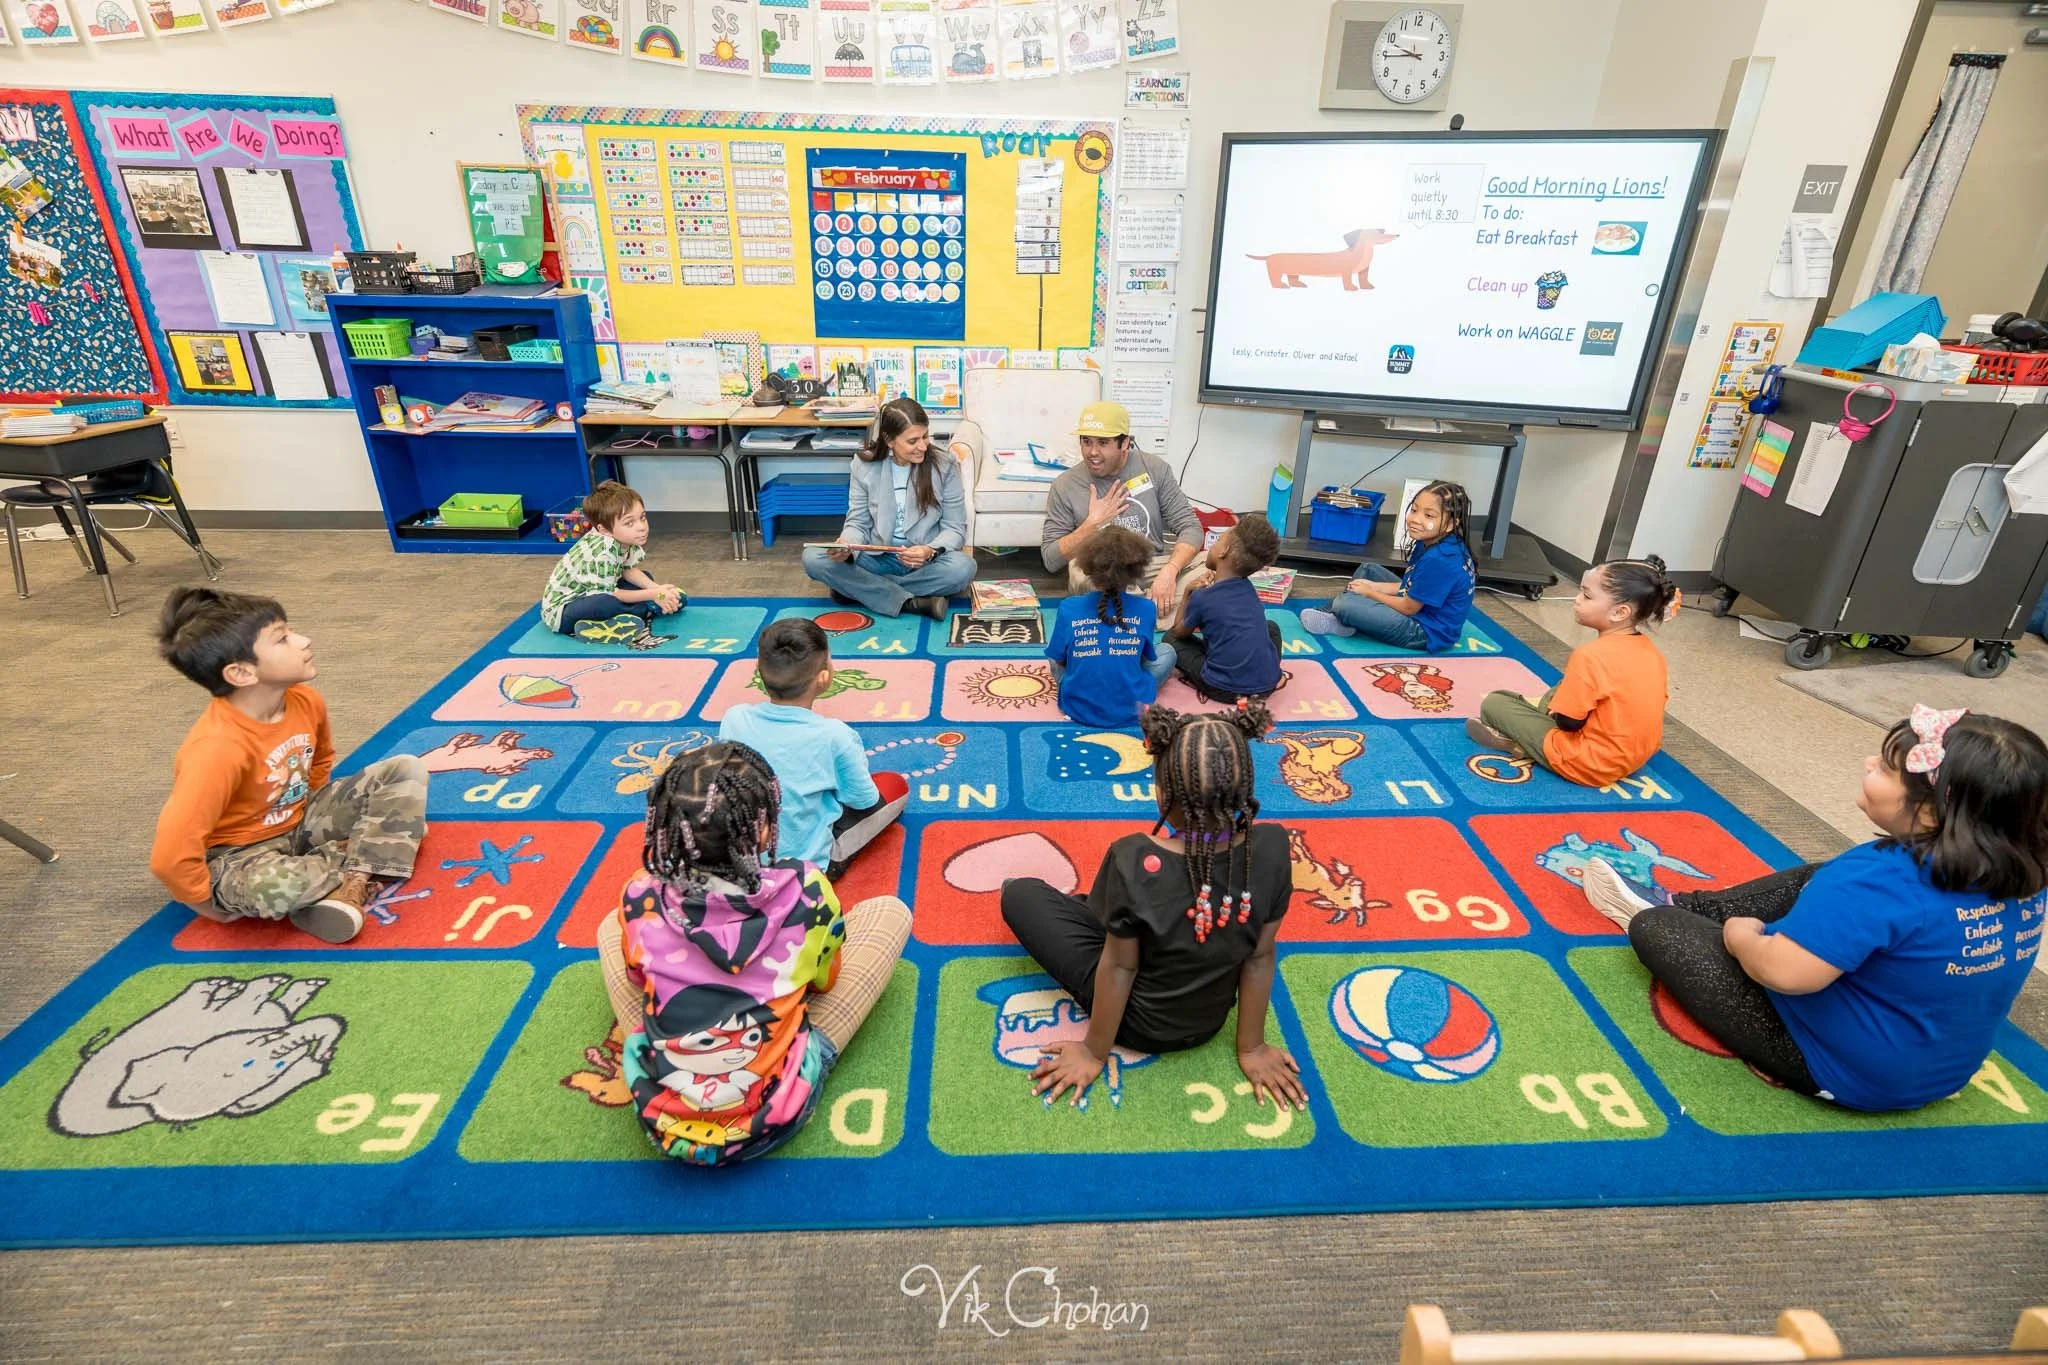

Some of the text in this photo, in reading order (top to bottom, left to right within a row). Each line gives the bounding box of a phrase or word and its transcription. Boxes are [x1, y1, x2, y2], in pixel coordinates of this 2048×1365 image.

[711, 5, 740, 35] Ss
[1013, 11, 1048, 38] Xx
[1400, 19, 1408, 31] 11
[1414, 15, 1424, 27] 12
[775, 14, 800, 41] Tt
[832, 17, 865, 43] Uu
[944, 16, 990, 43] Ww
[1387, 32, 1396, 44] 10
[1437, 33, 1443, 45] 2
[1382, 50, 1388, 61] 9
[1439, 51, 1445, 62] 3
[1383, 67, 1389, 78] 8
[1432, 68, 1438, 79] 4
[1392, 79, 1398, 90] 7
[1405, 84, 1411, 95] 6
[1420, 79, 1426, 90] 5
[115, 123, 339, 156] What Are We Doing?
[854, 172, 917, 188] February
[1413, 172, 1441, 184] Work
[1487, 175, 1669, 202] Good Morning Lions!
[1803, 181, 1839, 195] EXIT
[1411, 191, 1448, 206] quietly
[1408, 208, 1459, 221] until 8:30
[1483, 204, 1524, 220] To do:
[841, 218, 848, 228] 2
[1476, 228, 1579, 246] Eat Breakfast
[861, 242, 870, 252] 10
[820, 263, 829, 273] 15
[886, 264, 894, 274] 18
[1129, 268, 1167, 277] SUCCESS
[841, 286, 852, 296] 23
[1126, 280, 1169, 290] CRITERIA
[1467, 277, 1528, 298] Clean up
[1458, 323, 1577, 342] Work on WAGGLE
[1319, 352, 1333, 360] and
[874, 360, 905, 371] TURNS
[463, 777, 542, 809] Pp
[919, 783, 997, 809] Nn
[1405, 888, 1511, 932] Gg
[442, 895, 534, 942] Jj
[1964, 917, 2004, 941] Enfocado
[1961, 937, 2004, 958] Confiable
[1945, 954, 2007, 977] Responsable
[701, 1081, 718, 1105] R
[1519, 1072, 1652, 1130] Bb
[315, 1092, 441, 1153] Ee
